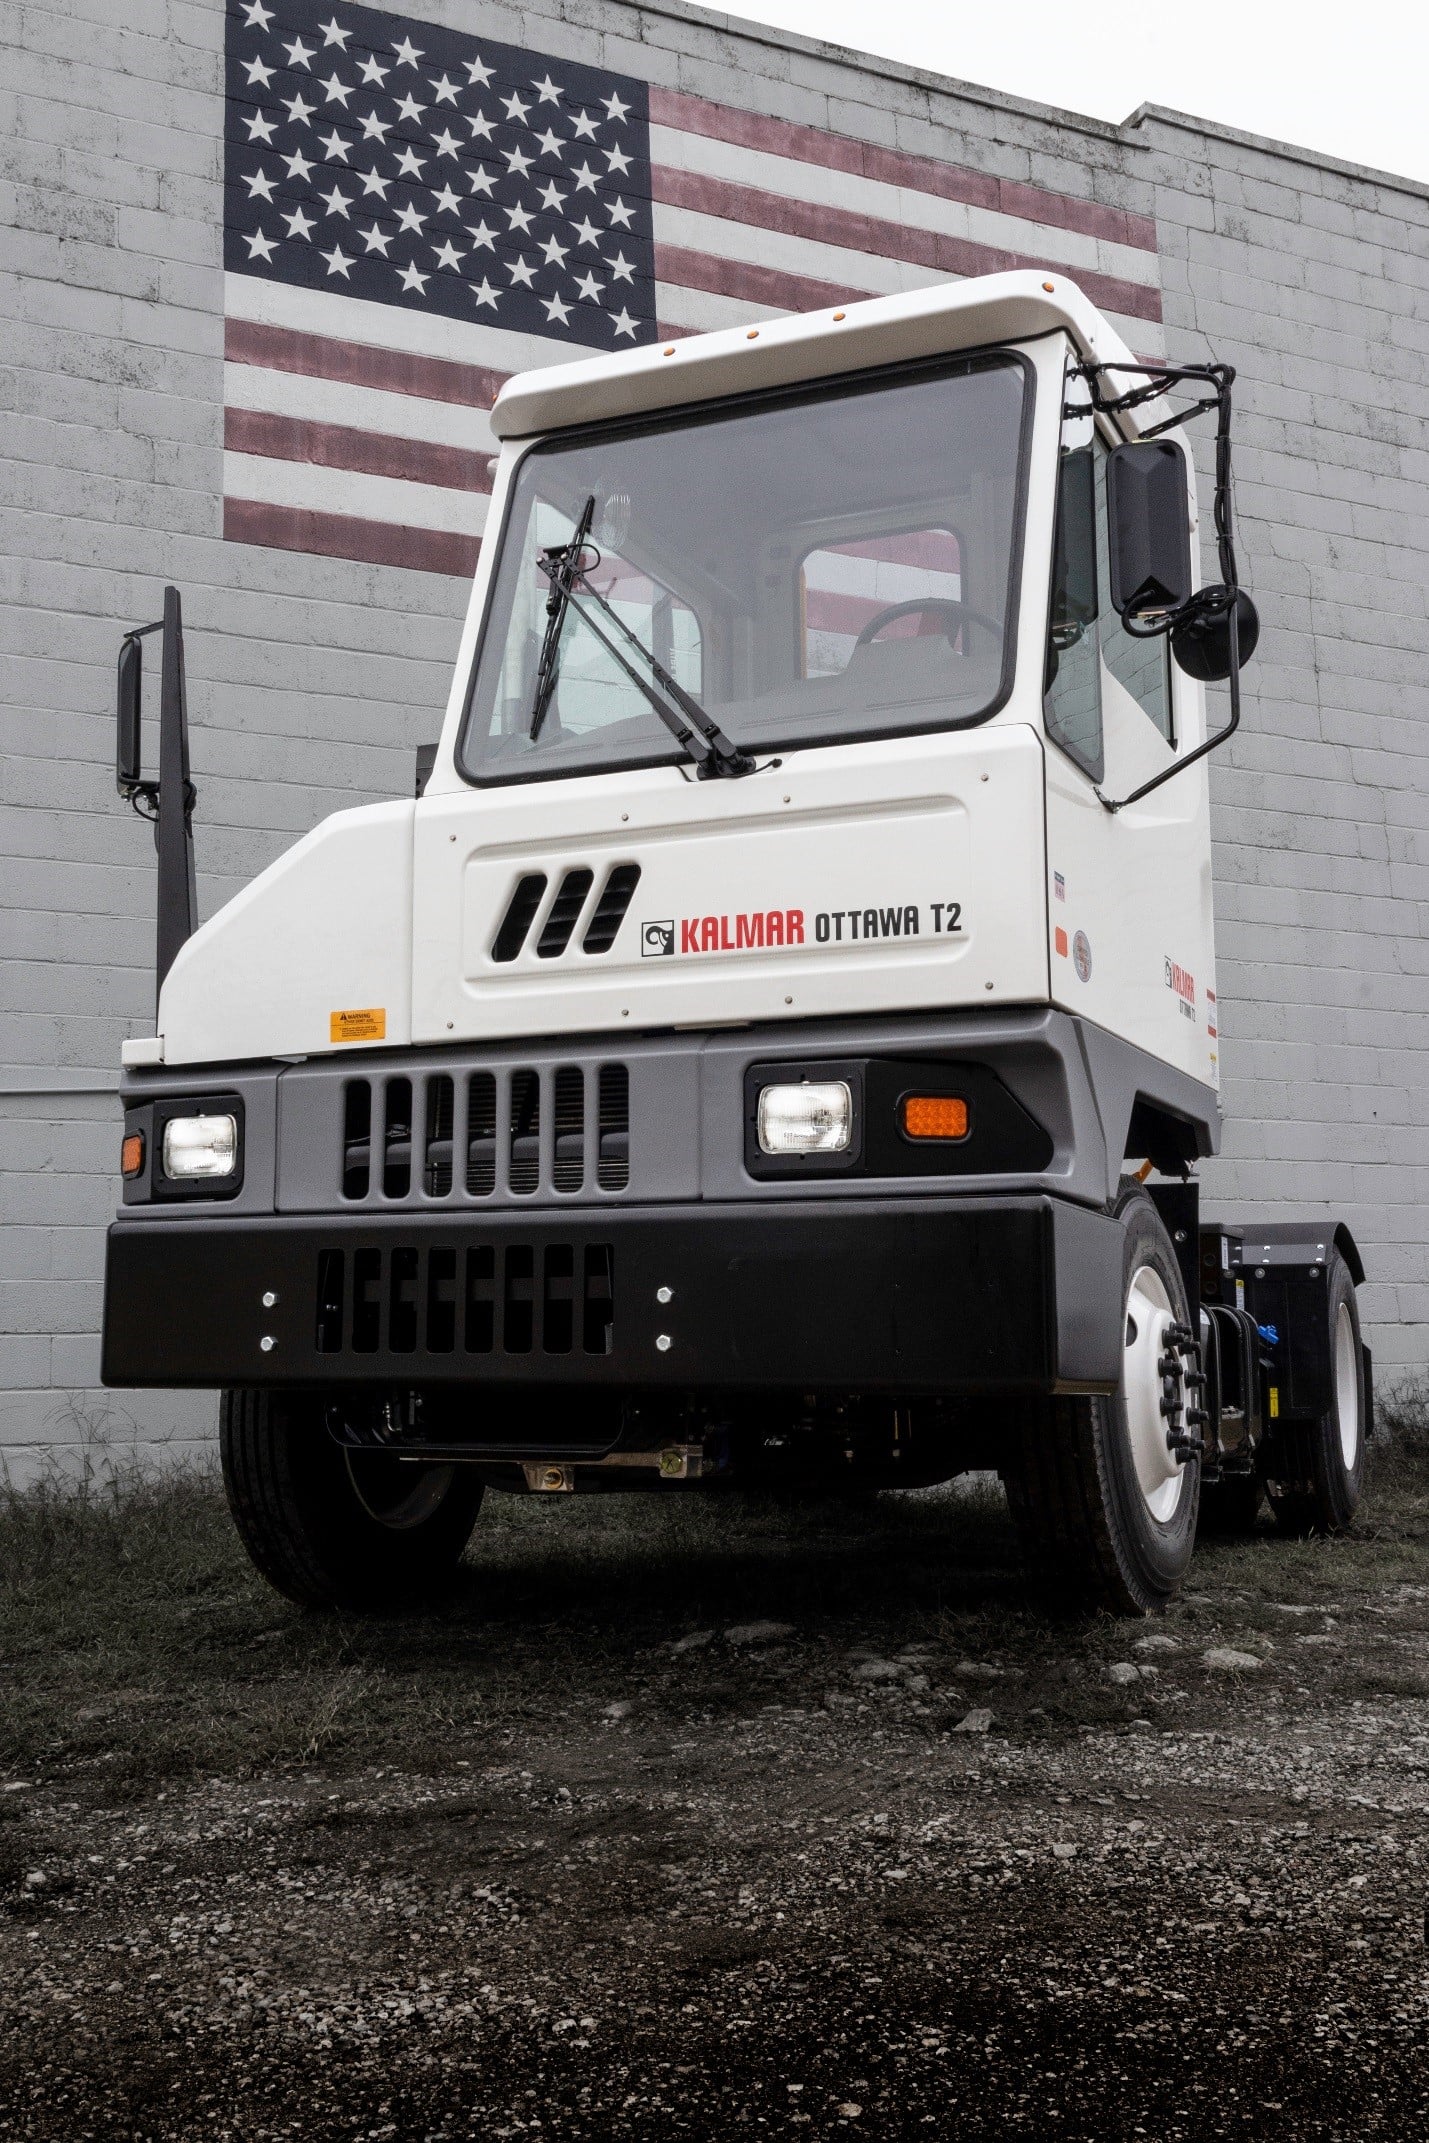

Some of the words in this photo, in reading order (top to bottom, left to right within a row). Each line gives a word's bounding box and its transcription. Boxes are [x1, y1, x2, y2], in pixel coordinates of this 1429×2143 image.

[681, 909, 805, 954] KALMAR
[815, 905, 920, 943] OTTAWA
[929, 902, 962, 933] T2
